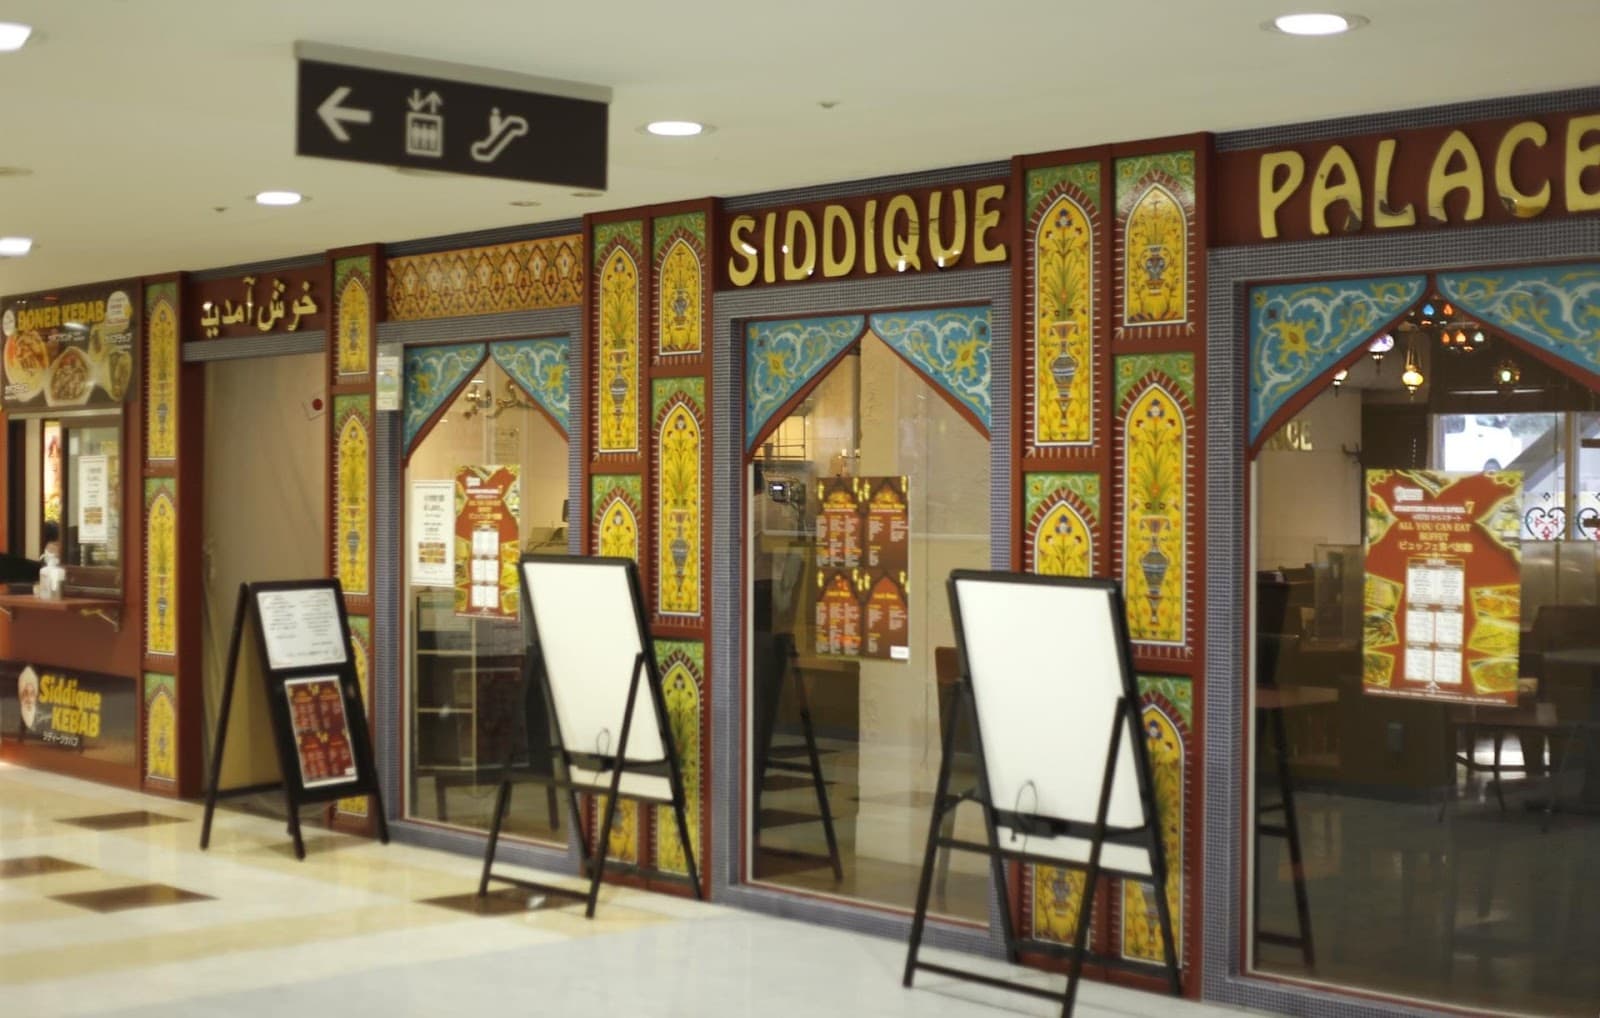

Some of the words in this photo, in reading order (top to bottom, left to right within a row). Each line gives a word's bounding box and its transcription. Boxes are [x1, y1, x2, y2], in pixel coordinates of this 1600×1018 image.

[1259, 114, 1600, 239] PALACE
[728, 184, 1008, 287] SIDDIQUE
[62, 300, 105, 323] KEBAB
[1435, 522, 1452, 531] CAN
[1454, 523, 1472, 532] EAT
[39, 675, 101, 712] Siddique
[51, 706, 100, 738] KEBAB
